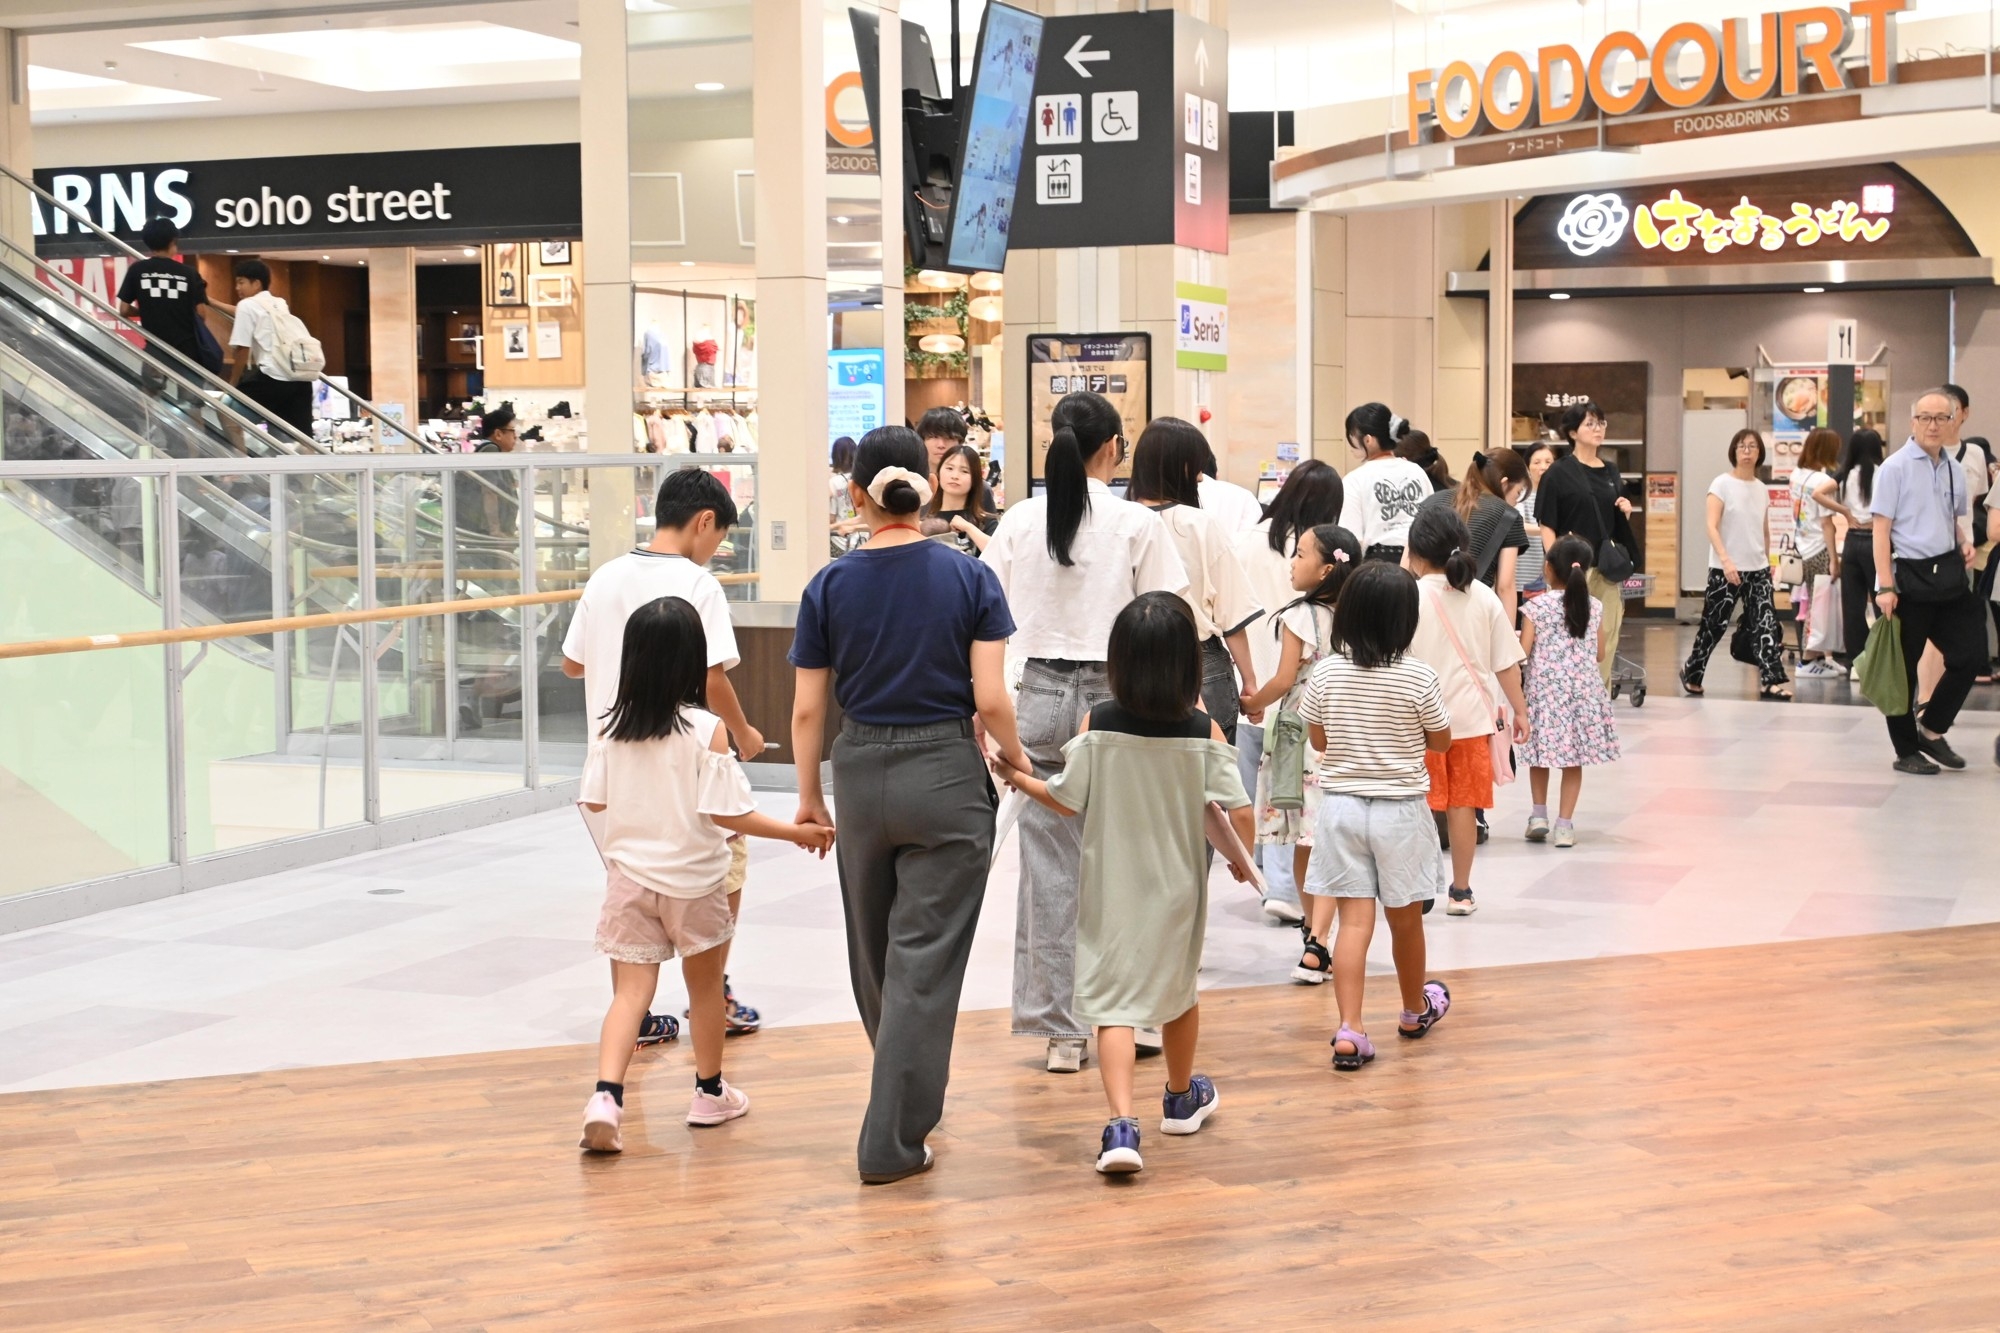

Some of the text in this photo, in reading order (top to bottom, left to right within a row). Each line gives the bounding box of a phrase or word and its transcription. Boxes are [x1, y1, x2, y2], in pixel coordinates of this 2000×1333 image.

[1408, 0, 1907, 146] FOODCOURT
[1673, 106, 1790, 134] FOODS&DRINKS
[1507, 134, 1564, 155] フードコート
[215, 182, 452, 228] soho street
[1633, 189, 1890, 253] はなまるうどん
[1193, 316, 1220, 342] Seria
[1051, 375, 1126, 392] 感謝デー
